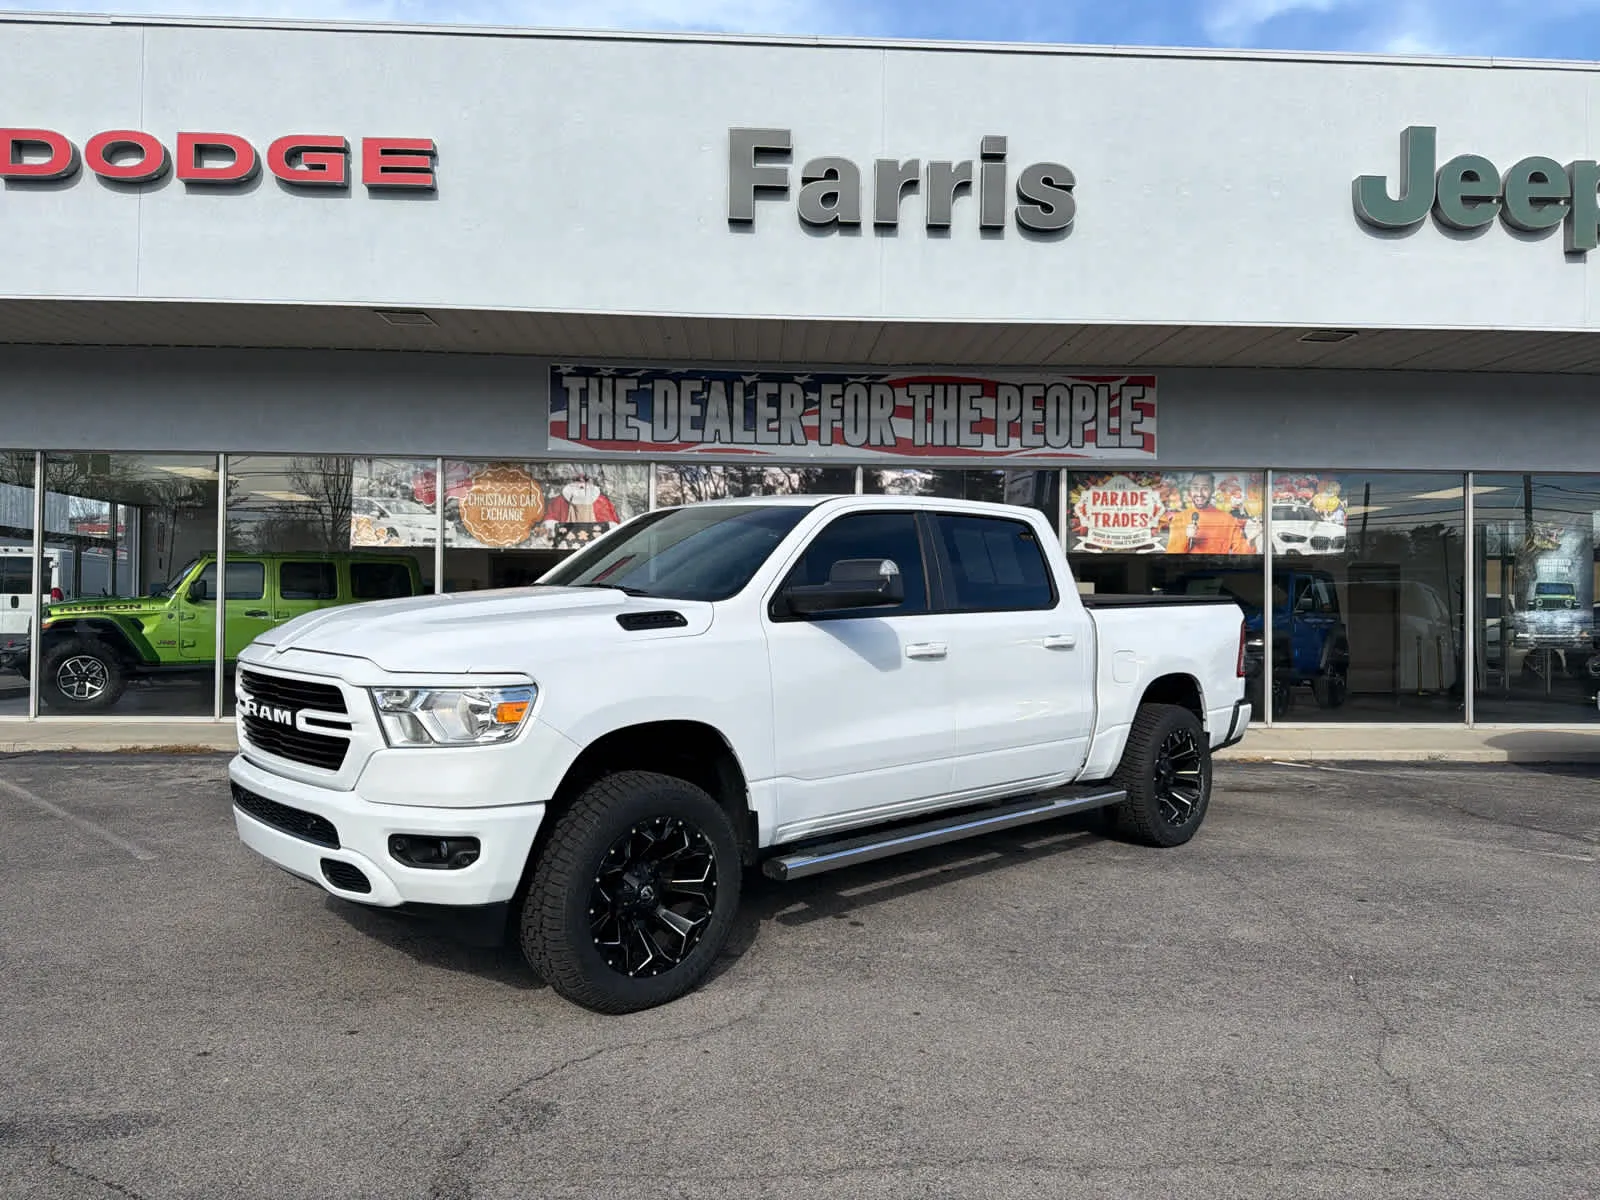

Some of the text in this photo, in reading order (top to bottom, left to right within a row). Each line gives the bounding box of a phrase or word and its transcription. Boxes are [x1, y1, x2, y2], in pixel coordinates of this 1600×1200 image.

[0, 128, 437, 190] DODGE
[728, 127, 1076, 232] Farris
[562, 375, 1146, 449] THE DEALER FOR THE PEOPLE
[468, 493, 537, 507] CHRISTMAS CAR
[1091, 490, 1148, 506] PARADE
[480, 507, 525, 522] EXCHANGE
[1091, 511, 1149, 528] TRADES
[59, 603, 142, 613] RUBICON
[245, 699, 292, 726] RAM
